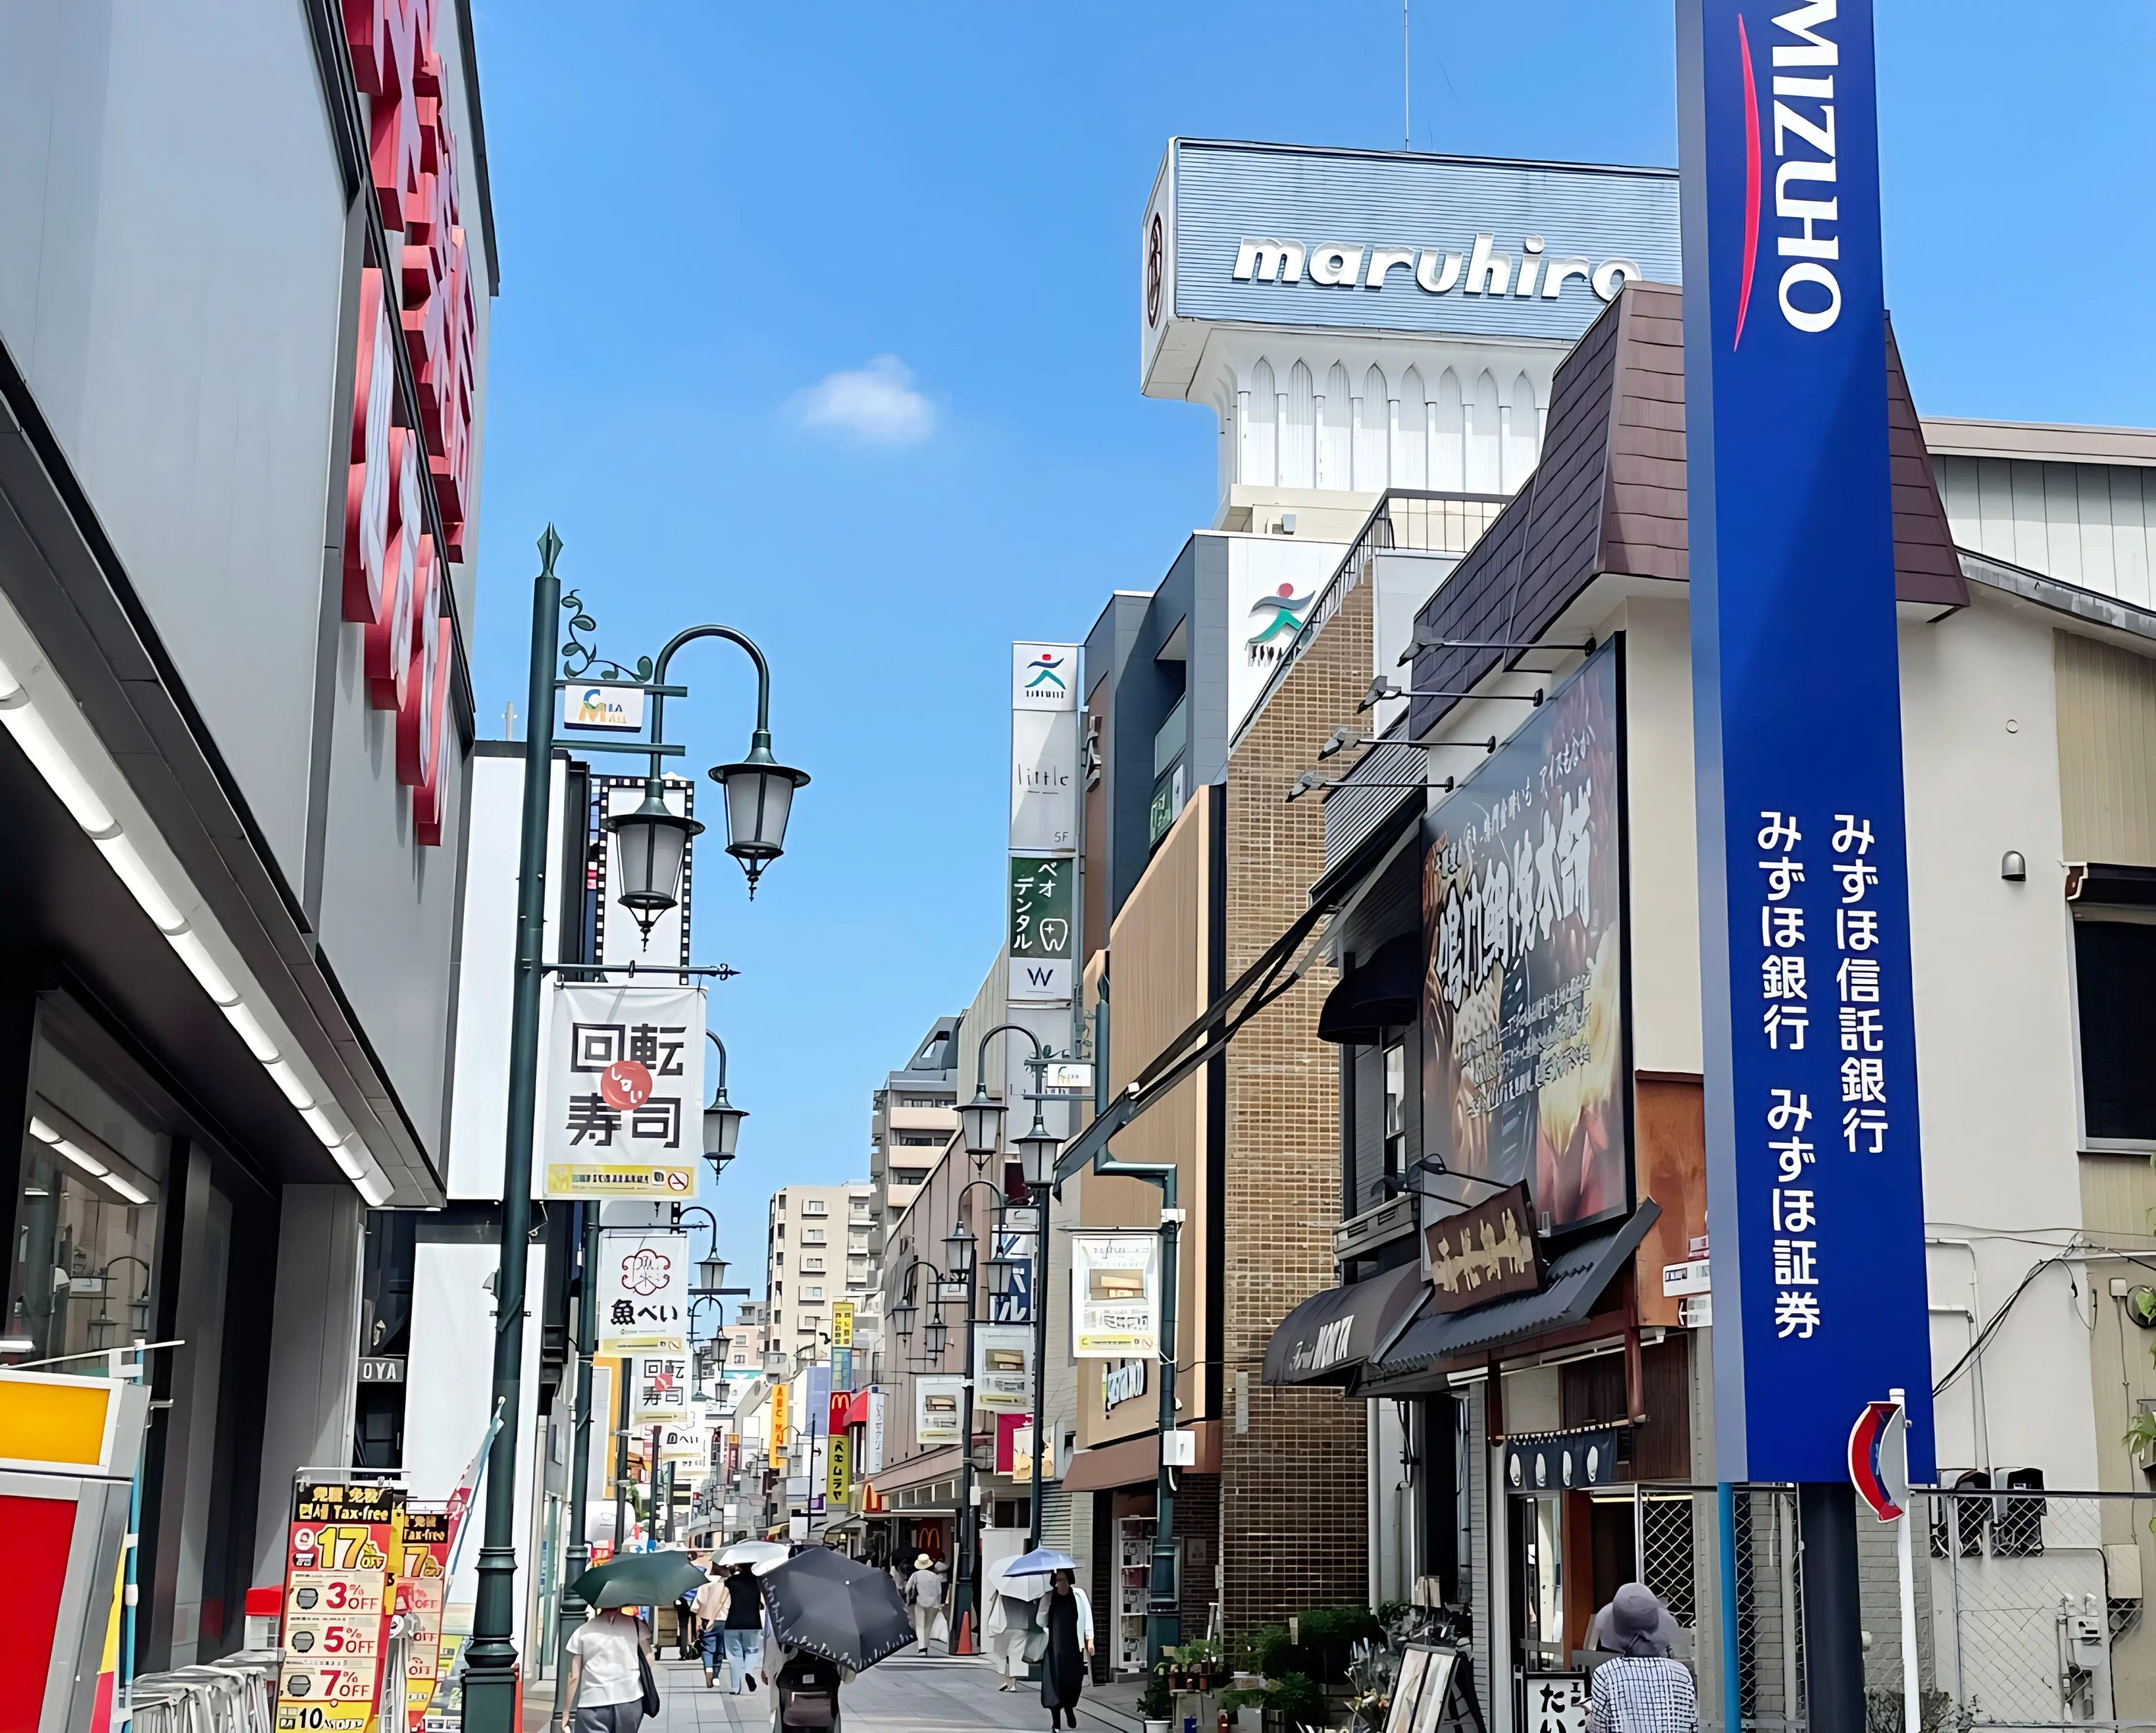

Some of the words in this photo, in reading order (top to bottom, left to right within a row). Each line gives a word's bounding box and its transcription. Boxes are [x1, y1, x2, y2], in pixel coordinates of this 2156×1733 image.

[1771, 0, 1841, 333] MIZUHO
[1233, 231, 1642, 302] maruhiro
[1013, 877, 1034, 949] デンタル
[1757, 812, 1809, 1050] みずほ銀行
[1832, 814, 1889, 1154] みずほ信託銀行
[571, 1023, 687, 1076] 回転
[566, 1093, 681, 1149] 寿司
[1767, 1089, 1820, 1338] みずほ証券
[611, 1298, 678, 1325] 魚べい
[363, 1363, 397, 1379] OYA
[348, 1598, 379, 1609] OFF
[346, 1640, 375, 1653] OFF
[339, 1685, 370, 1697] OFF
